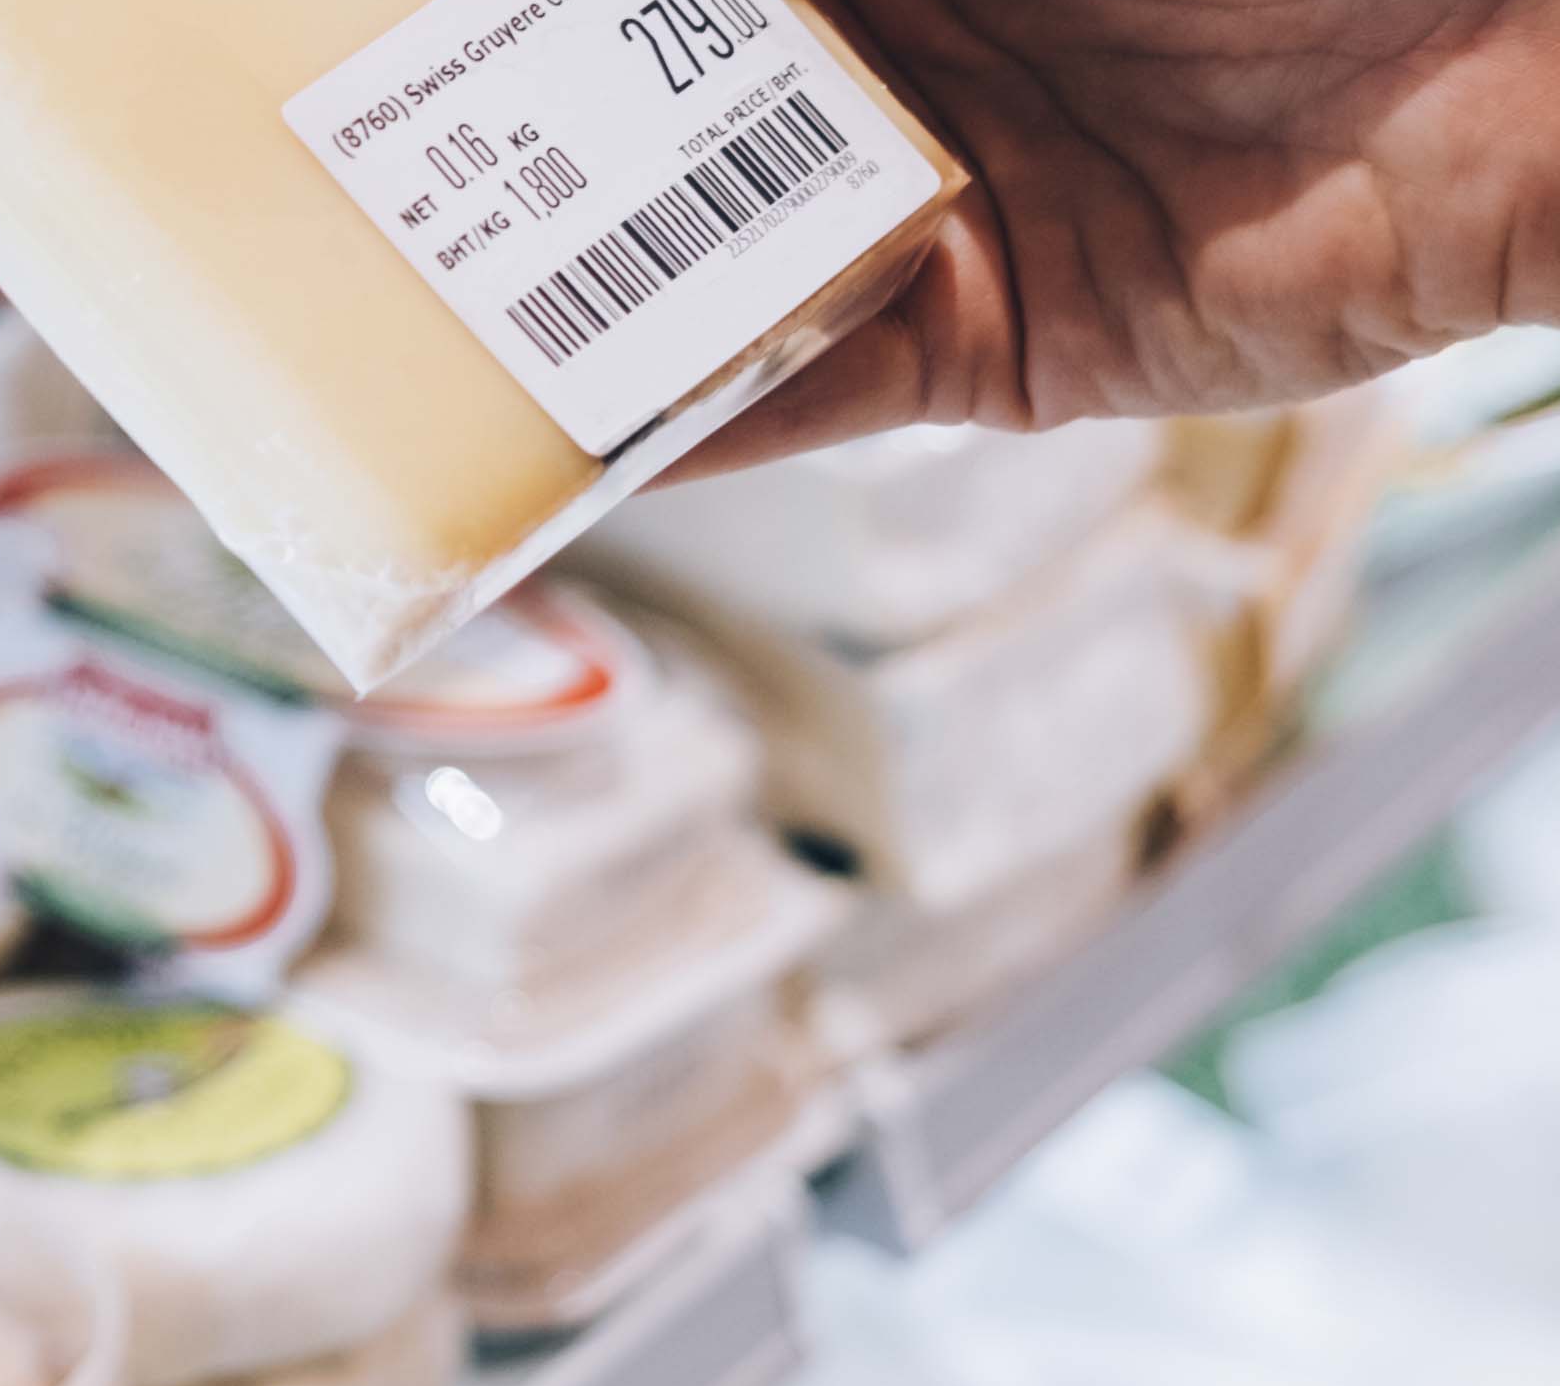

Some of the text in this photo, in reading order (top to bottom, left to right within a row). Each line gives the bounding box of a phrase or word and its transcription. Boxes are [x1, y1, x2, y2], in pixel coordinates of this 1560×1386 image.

[332, 94, 412, 159] (8760)
[404, 55, 468, 107] Swiss
[465, 0, 546, 67] Gruyere
[677, 60, 809, 161] TOTAL PRICE/BHT.
[400, 120, 541, 231] NET 0.16 KG
[435, 145, 589, 273] BHT/KG 1,800
[844, 159, 881, 192] 8760
